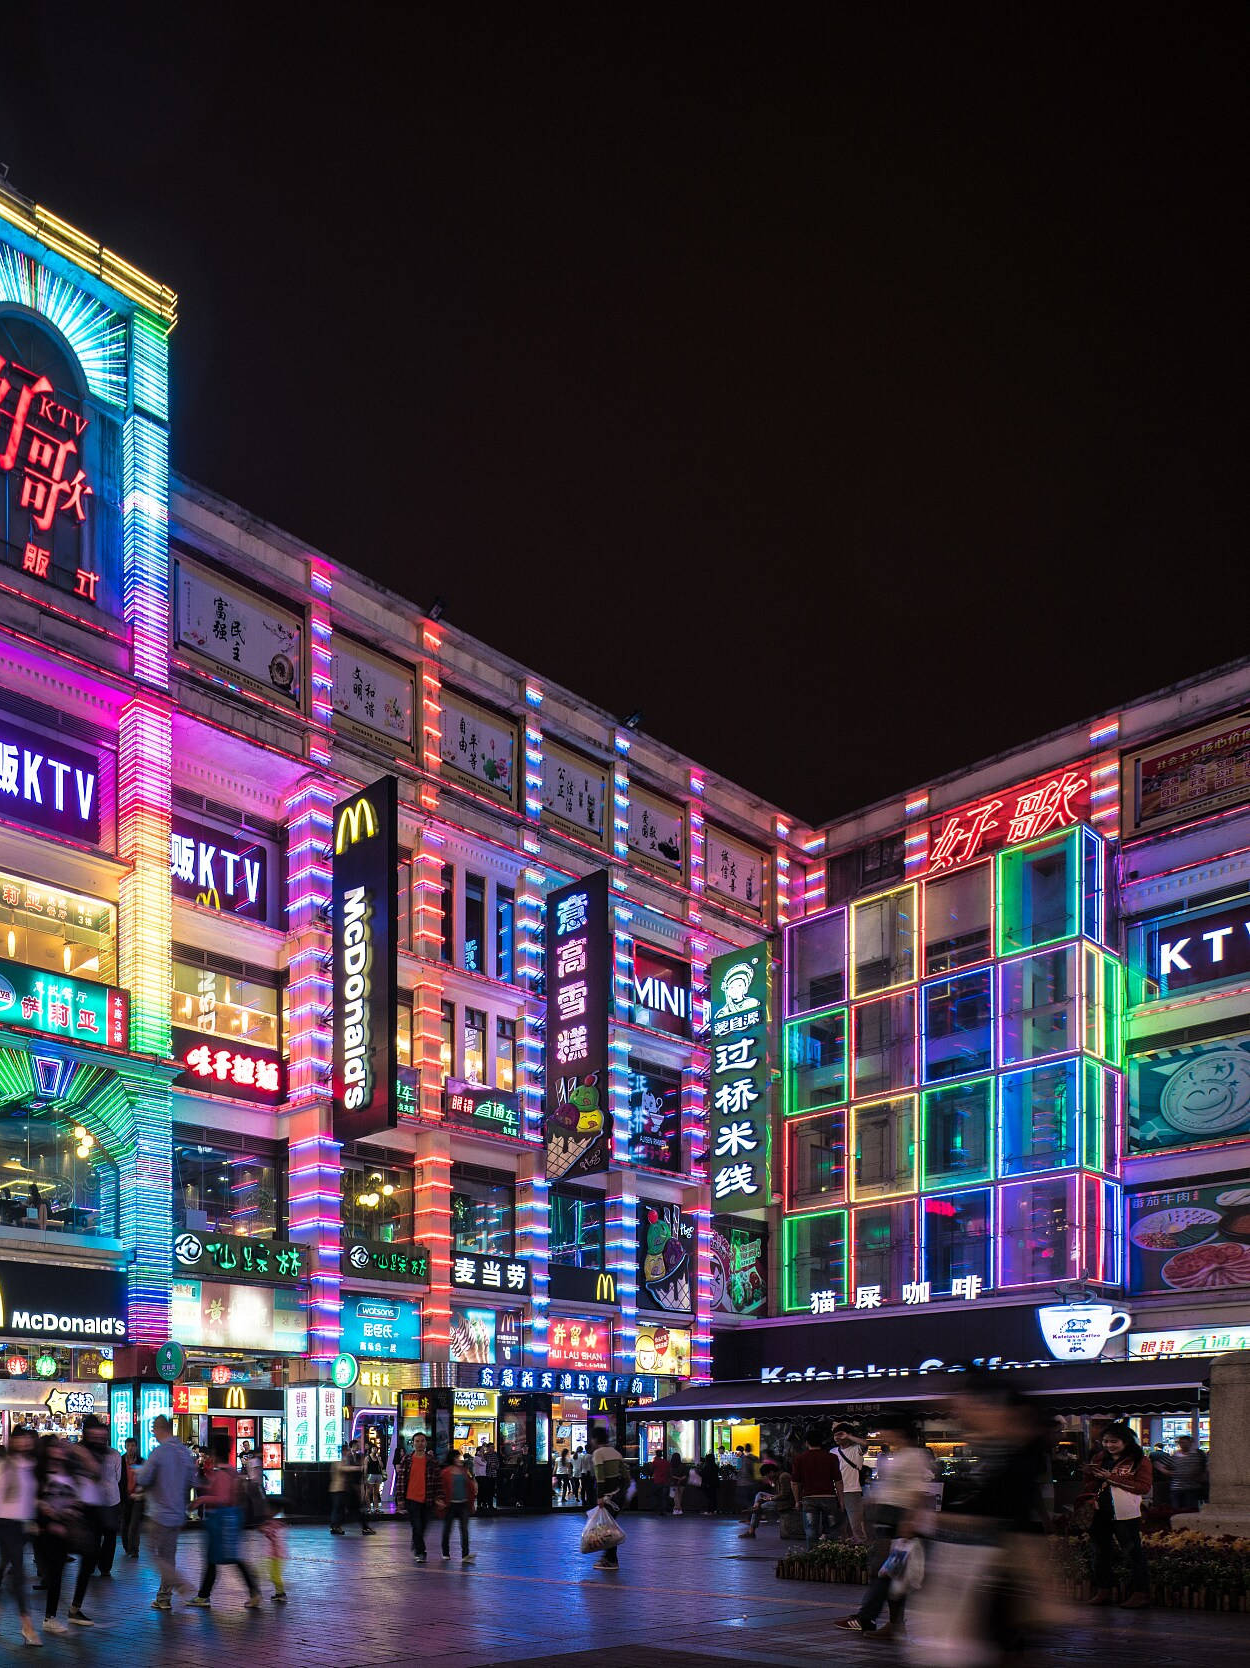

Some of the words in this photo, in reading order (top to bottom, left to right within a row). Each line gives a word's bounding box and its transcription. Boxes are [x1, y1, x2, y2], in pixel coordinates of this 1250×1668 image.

[38, 397, 89, 436] KTV
[353, 667, 363, 702] 文明
[458, 718, 467, 753] 自由
[469, 735, 479, 770] 平等
[557, 767, 566, 799] 公正
[928, 771, 1088, 874] 好歌
[1160, 921, 1250, 975] KT
[556, 893, 588, 1064] 意高雪糕
[634, 976, 686, 1019] MINI
[21, 995, 99, 1033] 萨莉亚
[344, 886, 367, 1110] McDonald's
[714, 1039, 759, 1199] 过桥米线
[454, 1257, 526, 1290] 麦当劳
[810, 1275, 983, 1315] 猫屎咖啡
[11, 1311, 126, 1336] McDonald's
[363, 1322, 393, 1338] 屈臣氏
